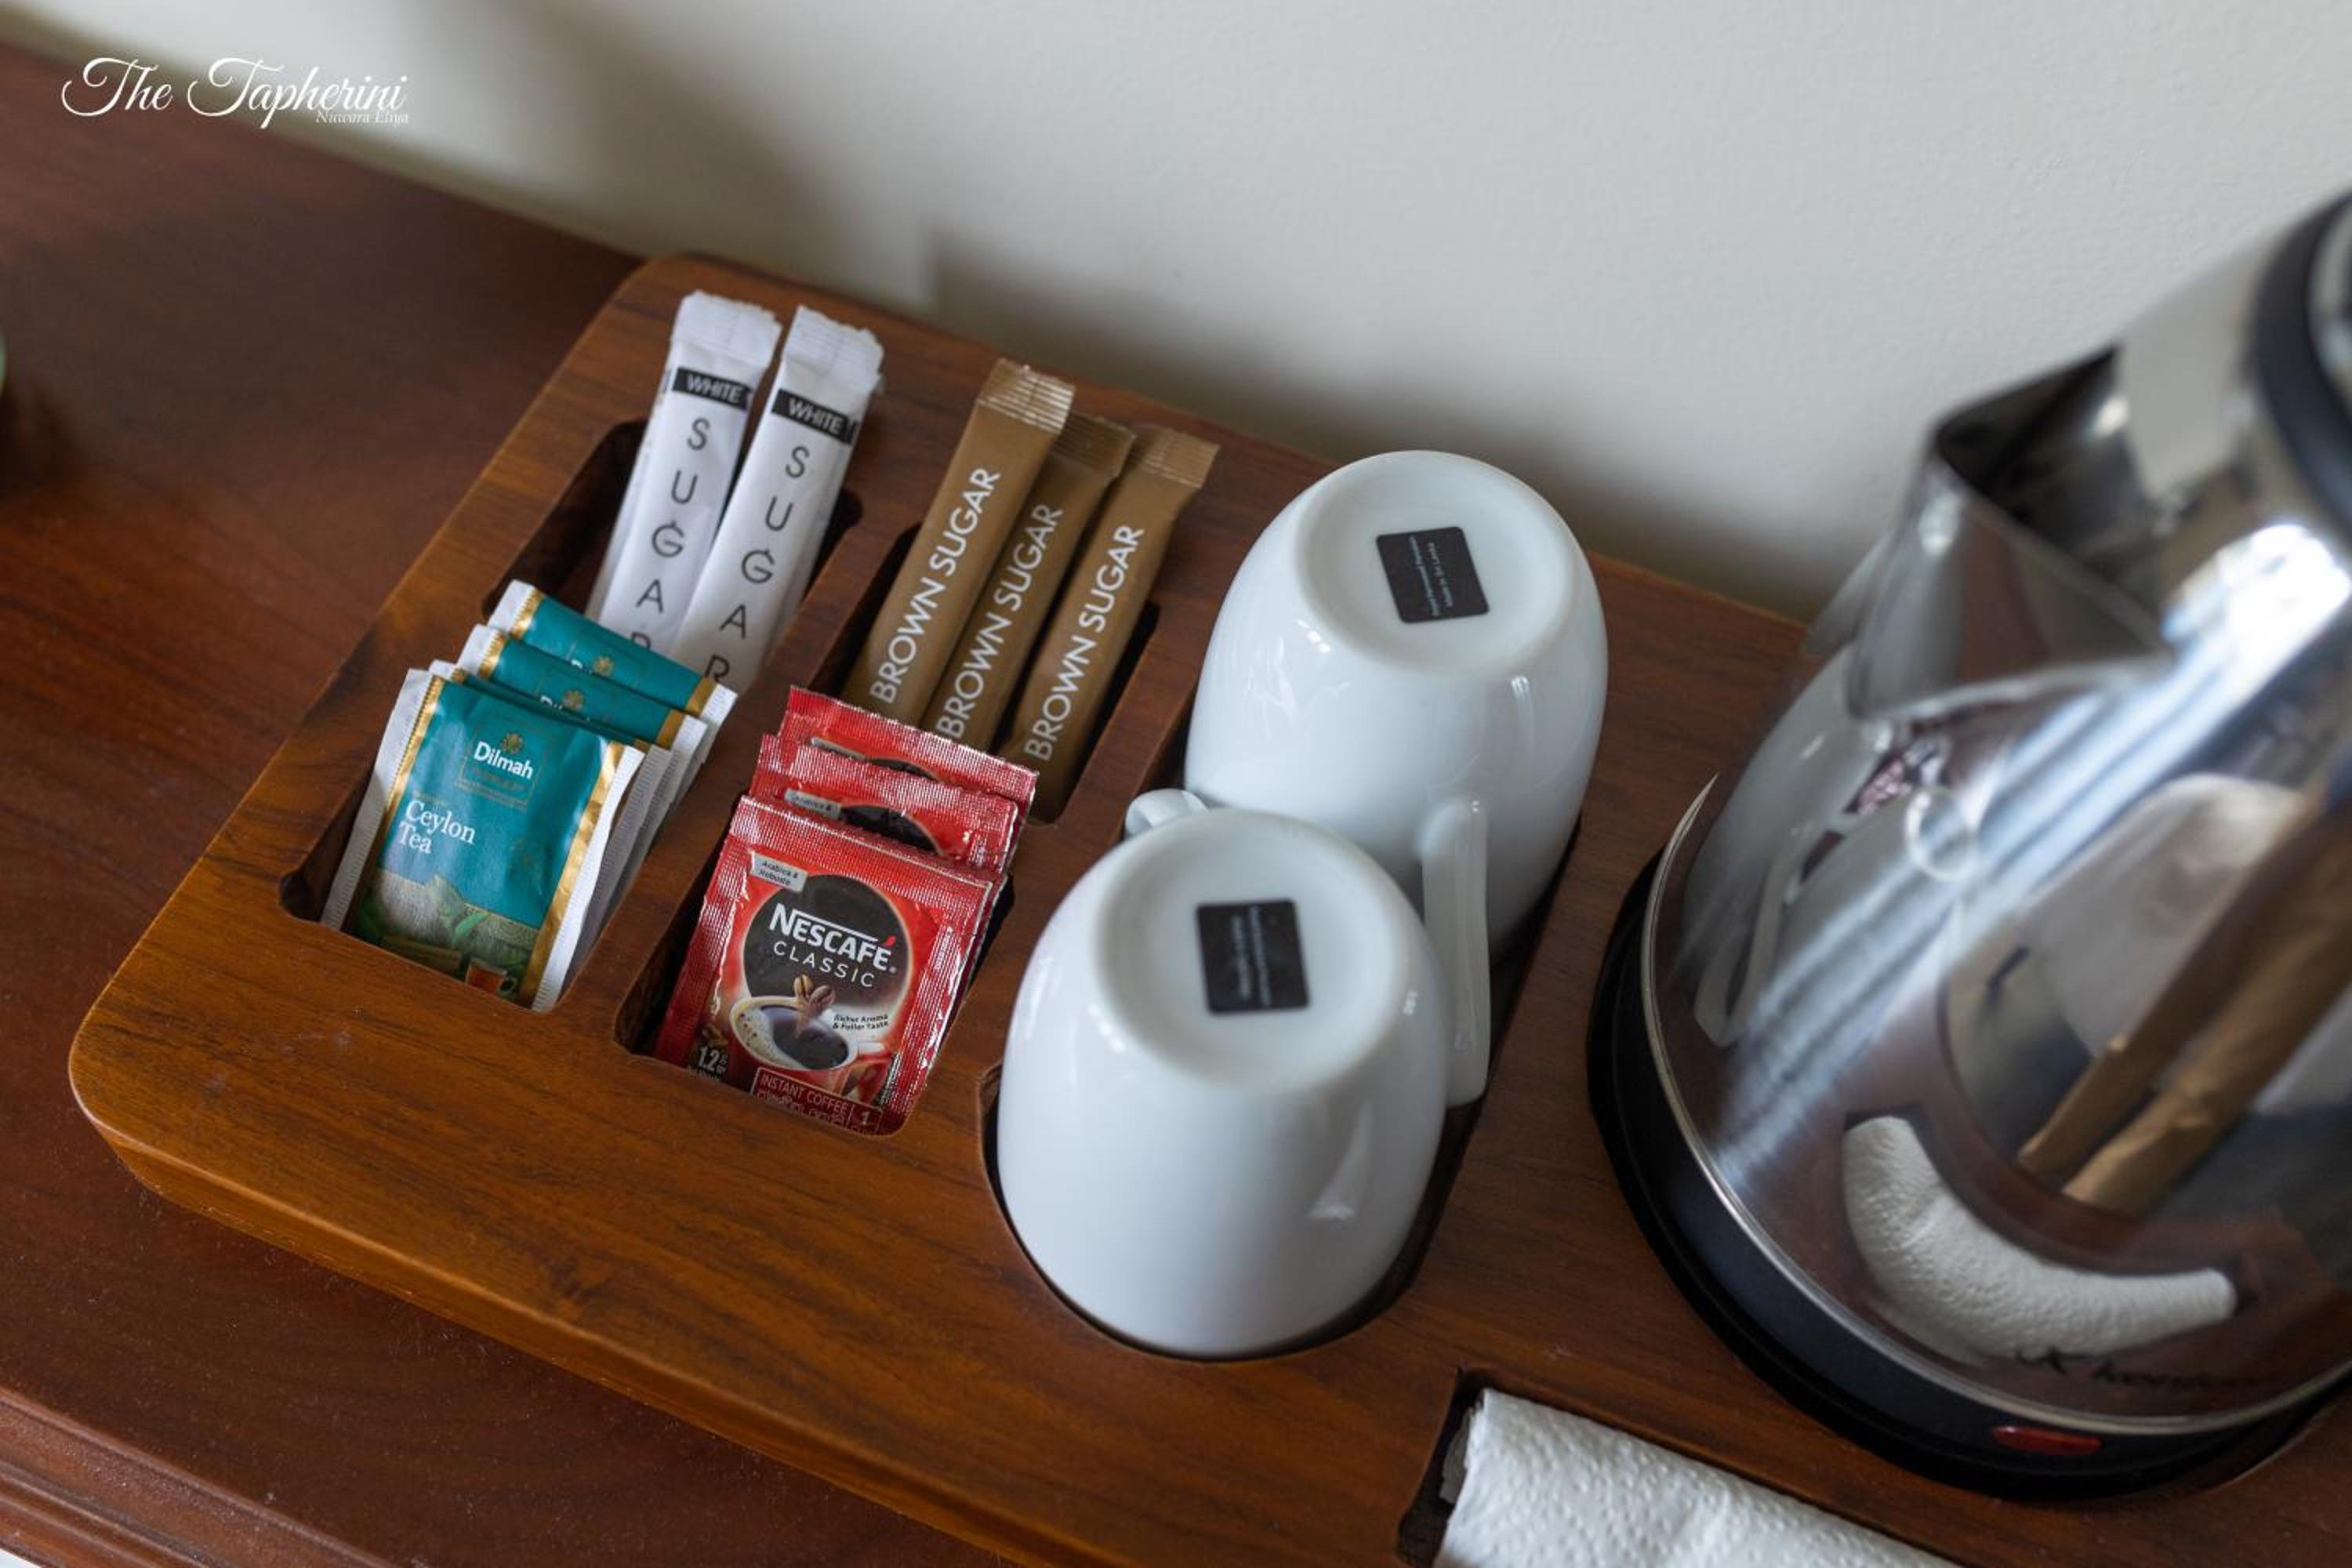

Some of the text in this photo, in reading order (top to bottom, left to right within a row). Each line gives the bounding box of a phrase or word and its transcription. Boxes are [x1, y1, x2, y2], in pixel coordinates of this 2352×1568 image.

[686, 375, 744, 404] WHITE
[789, 399, 844, 433] WHITE
[706, 446, 811, 683] SUGAR
[870, 467, 1001, 703] BROWN SUGAR
[936, 504, 1063, 739] BROWN SUGAR
[1024, 524, 1145, 760] BROWN SUGAR
[474, 741, 533, 779] Dilmah
[400, 821, 432, 854] Tea
[406, 800, 476, 844] Ceylon
[769, 902, 896, 971] NESCAFÉ
[774, 941, 875, 987] CLASSIC
[760, 1073, 804, 1098] INSTANT
[806, 1090, 849, 1114] COFFEE
